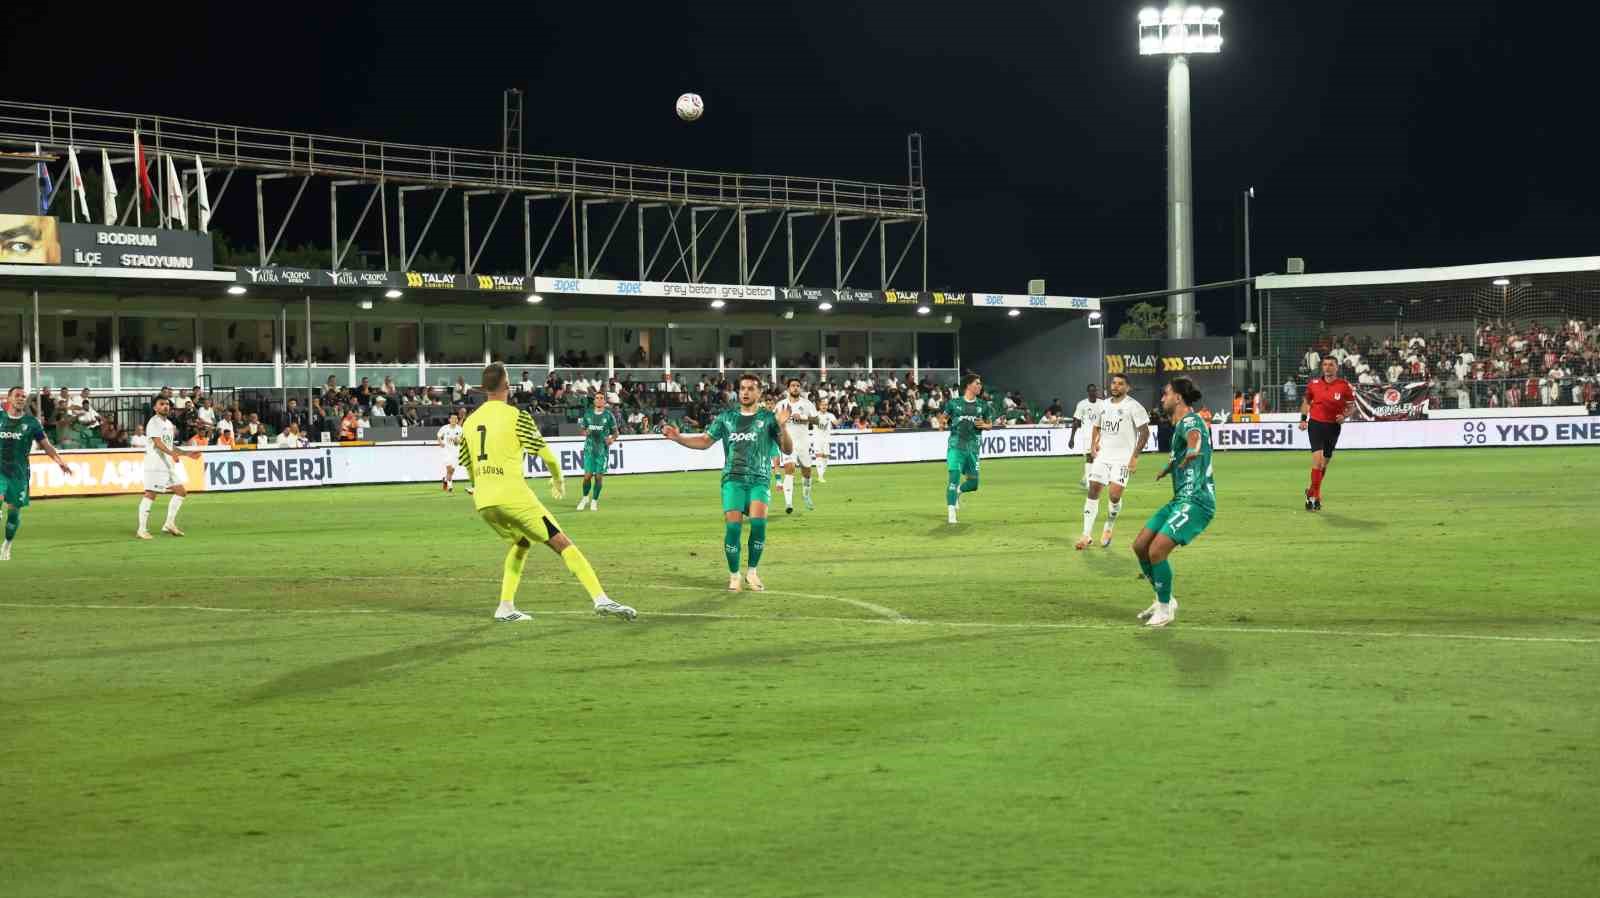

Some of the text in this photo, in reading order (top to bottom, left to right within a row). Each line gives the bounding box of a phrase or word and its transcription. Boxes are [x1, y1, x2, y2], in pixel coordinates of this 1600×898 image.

[97, 232, 157, 246] BODRUM
[74, 249, 193, 268] İLÇE STADYUMU
[422, 273, 455, 283] TALAY
[492, 276, 524, 286] TALAY
[664, 283, 716, 295] grey beton
[722, 285, 771, 297] grey beton
[896, 291, 919, 300] TALAY
[944, 293, 966, 301] TALAY
[1123, 355, 1158, 367] TALAY
[1183, 355, 1230, 366] TALAY
[1219, 424, 1294, 445] ENERJİ
[1496, 425, 1548, 441] YKD
[477, 425, 488, 461] 1
[1010, 430, 1051, 452] ENERJİ
[560, 443, 624, 470] ENJİ
[204, 449, 333, 485] KD ENERJİ
